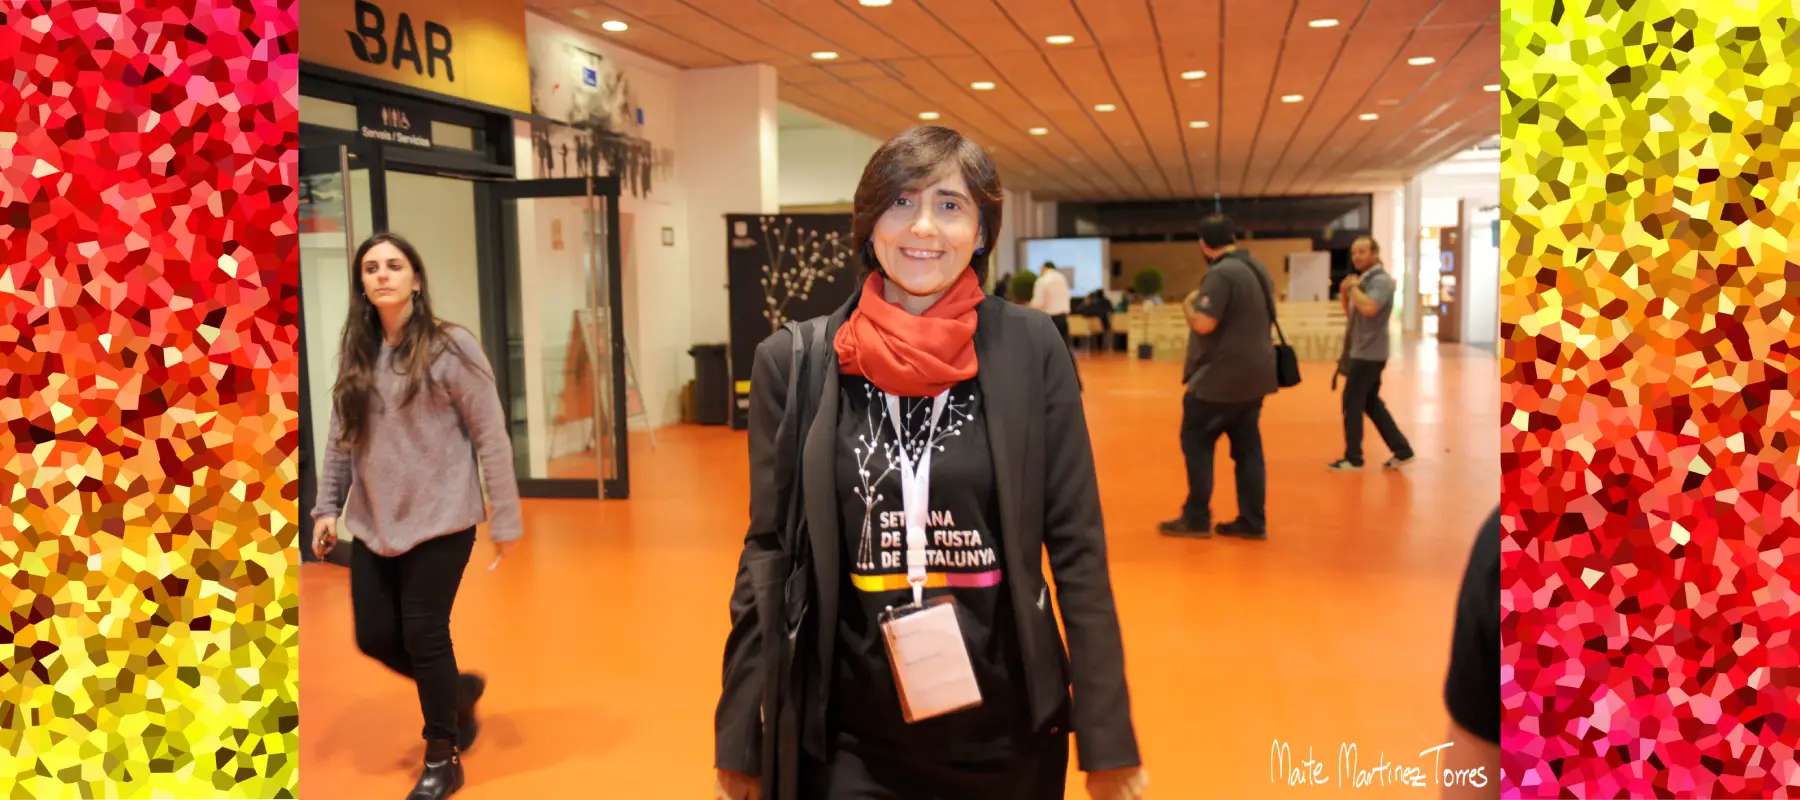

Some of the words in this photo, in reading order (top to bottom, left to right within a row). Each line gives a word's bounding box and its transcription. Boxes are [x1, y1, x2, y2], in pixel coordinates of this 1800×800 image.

[344, 0, 455, 82] BAR
[881, 531, 901, 548] DE
[934, 529, 982, 548] FUSTA
[881, 551, 901, 568] DE
